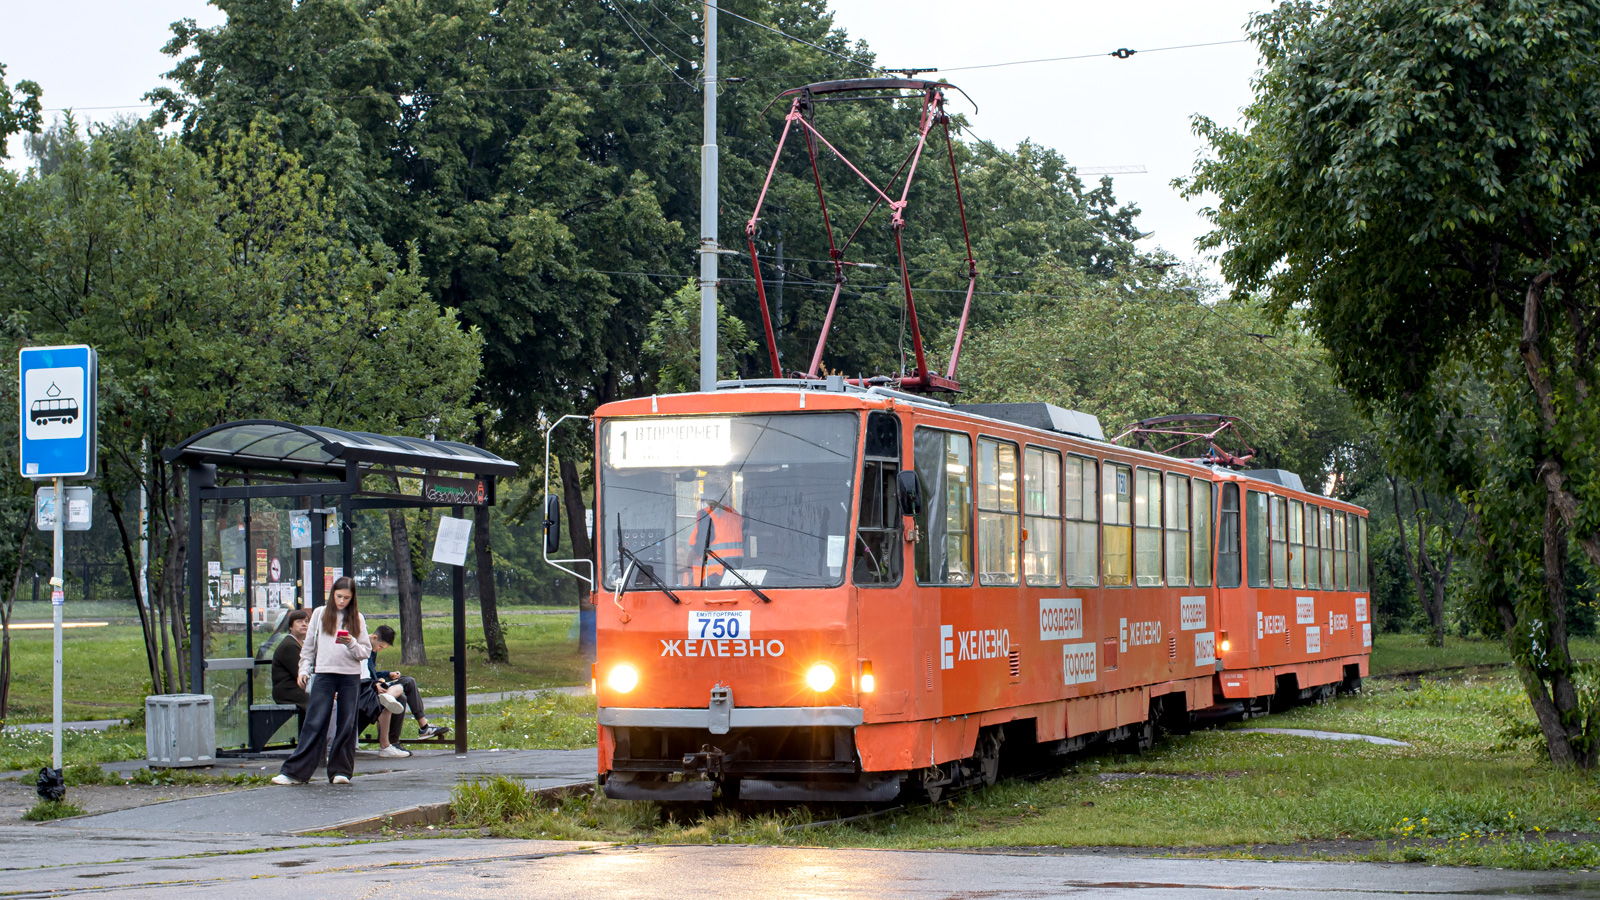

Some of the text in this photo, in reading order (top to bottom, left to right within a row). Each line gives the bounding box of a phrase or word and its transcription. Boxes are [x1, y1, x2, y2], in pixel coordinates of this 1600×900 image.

[620, 431, 627, 460] 1
[635, 425, 721, 440] ВТОРЧЕРМЕТ
[698, 618, 740, 638] 750
[1041, 607, 1081, 636] создаем
[1129, 620, 1162, 646] ЖЕЛЕЗНО
[660, 639, 784, 657] ЖЕЛЕЗНО
[958, 628, 1010, 661] ЖЕЛЕЗНО
[1064, 651, 1095, 684] города
